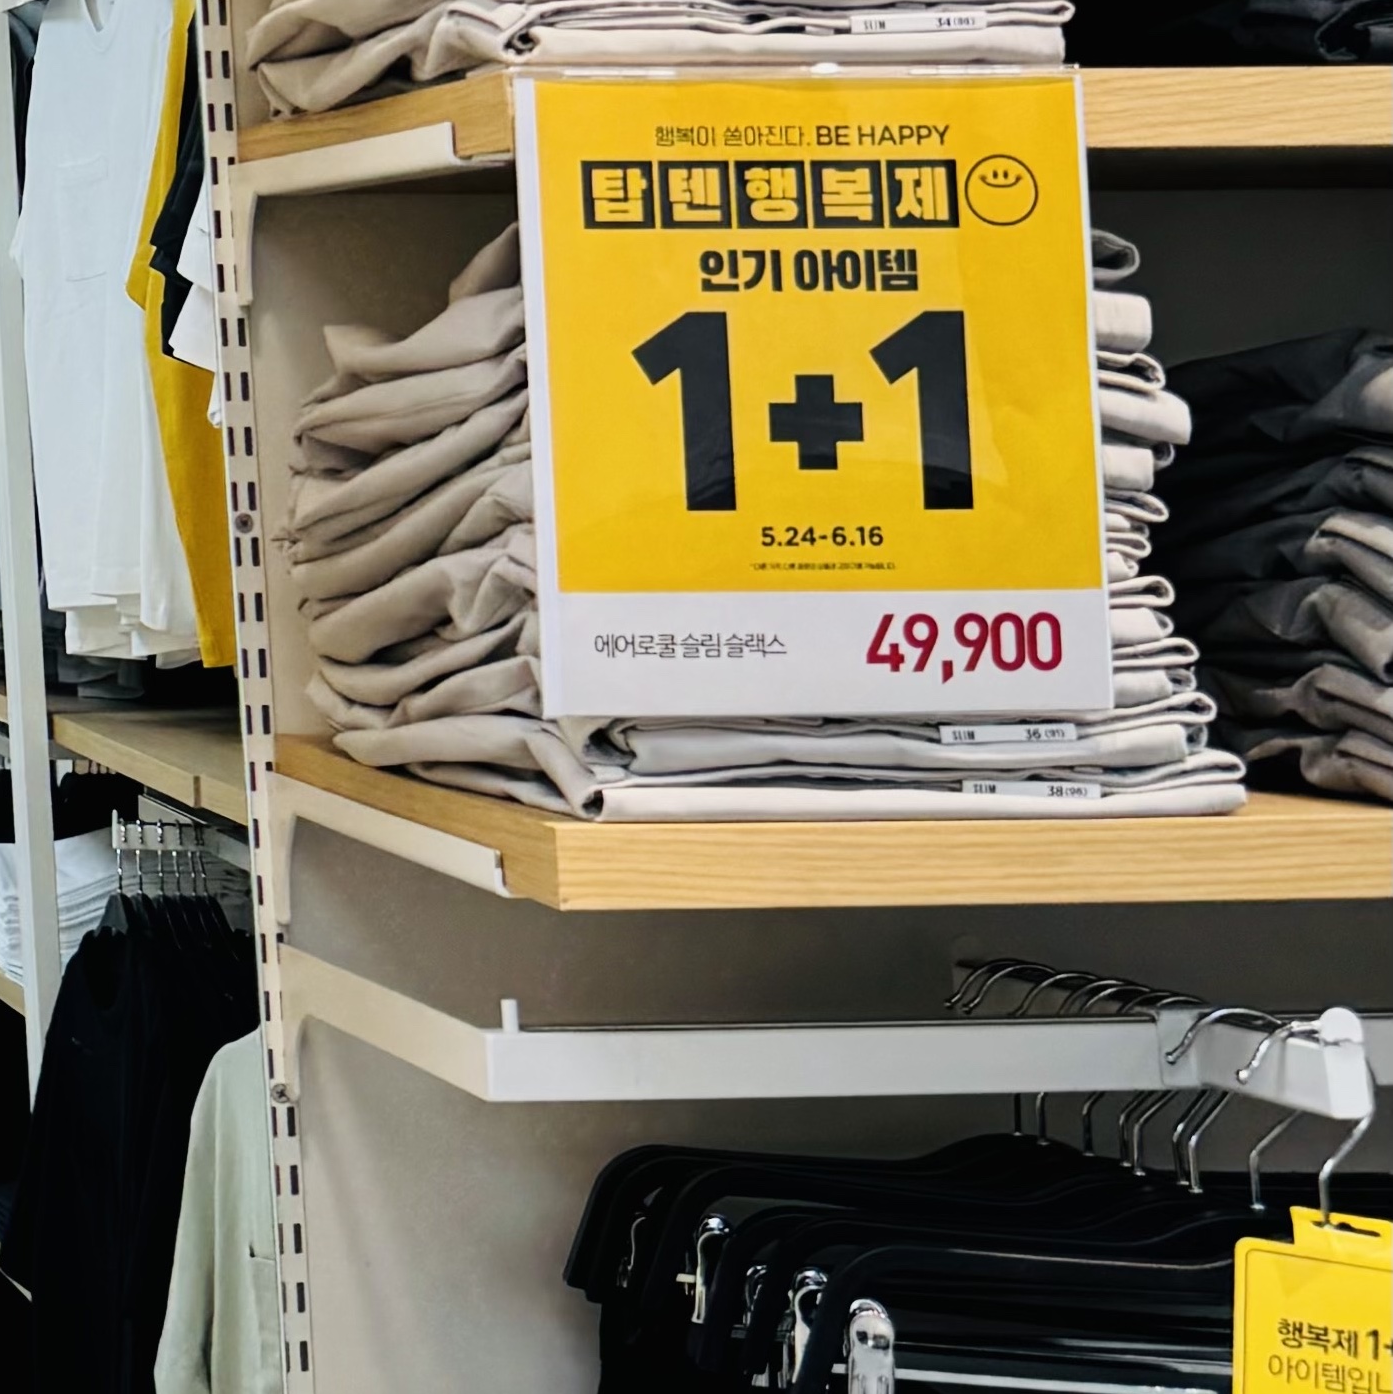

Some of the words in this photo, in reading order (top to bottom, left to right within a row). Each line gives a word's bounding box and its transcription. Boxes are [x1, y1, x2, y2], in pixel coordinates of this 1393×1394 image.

[655, 125, 715, 148] 행복이
[815, 125, 851, 147] BE
[857, 125, 950, 147] HAPPY
[699, 248, 784, 293] 인기
[793, 248, 919, 293] 아이템
[630, 309, 975, 512] 1+1
[760, 525, 884, 548] 5.24-6.16
[594, 632, 677, 658] 에어로쿨
[679, 632, 722, 658] 슬림
[723, 632, 788, 658] 슬랙스
[865, 610, 1063, 684] 49,900
[1277, 1317, 1359, 1360] 행복제
